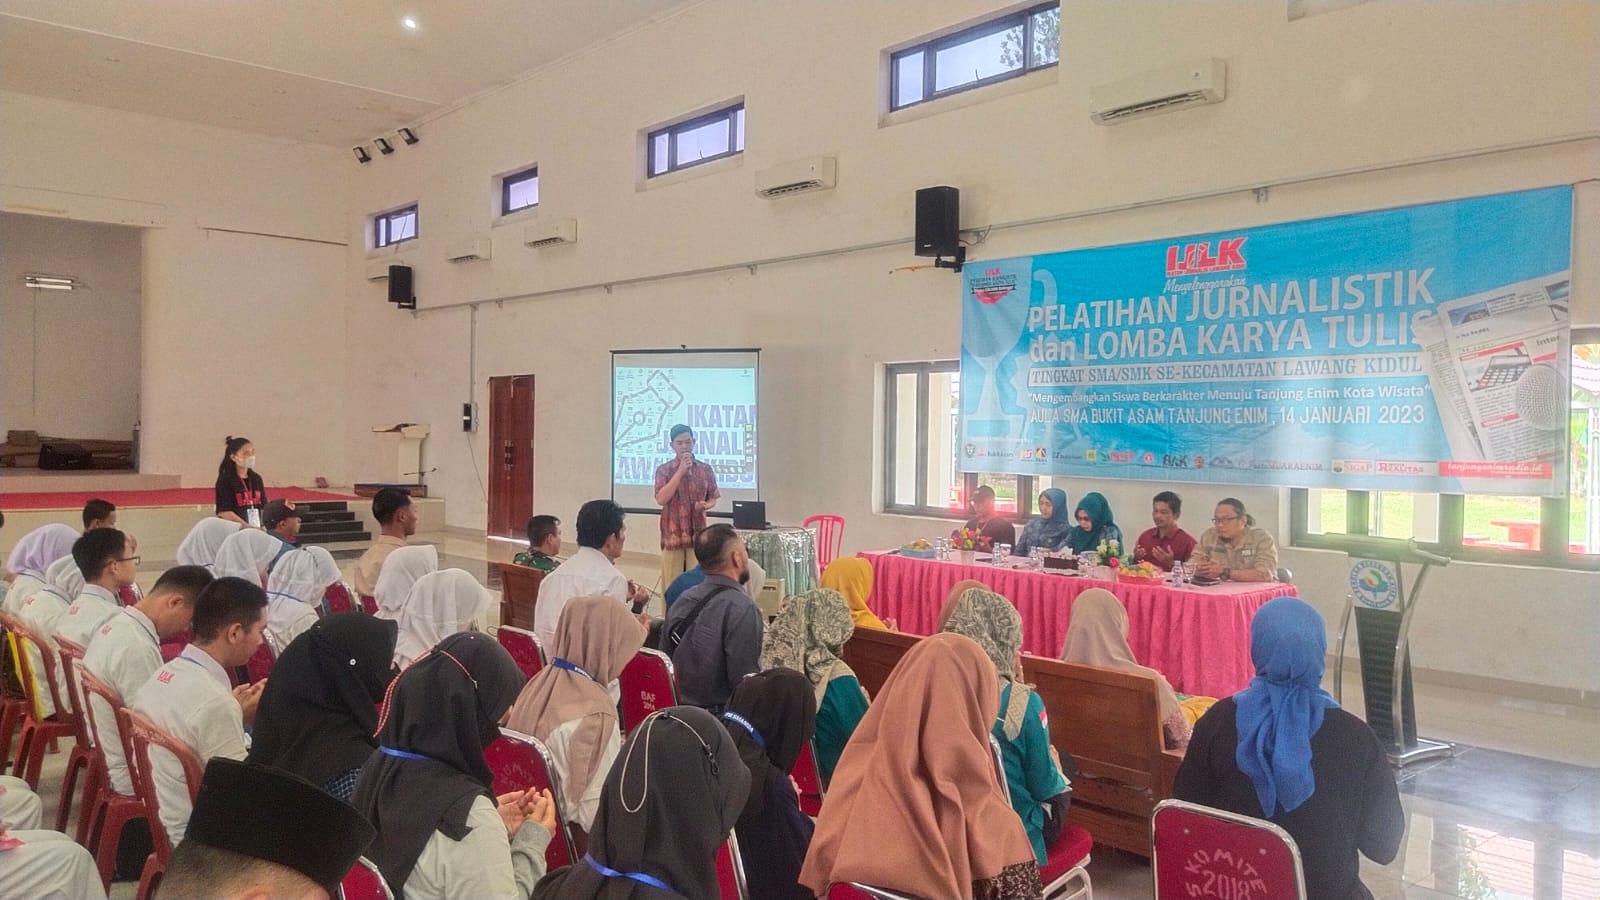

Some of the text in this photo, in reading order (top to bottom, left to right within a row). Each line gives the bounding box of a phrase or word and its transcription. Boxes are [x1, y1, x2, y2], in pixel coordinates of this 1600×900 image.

[1028, 268, 1435, 332] PELATIHAN JURNALISTIK
[1030, 334, 1077, 362] dan
[1083, 327, 1188, 361] LOMBA
[1197, 318, 1312, 355] KARYA
[1032, 355, 1424, 384] TINGKAT SMA/SMK SE-KECAMATAN LAWANG KIDUL
[1112, 391, 1140, 402] Siswa
[1142, 390, 1206, 402] Berkarakter
[1207, 389, 1252, 403] Menuju
[1255, 387, 1303, 401] Tanjung
[1306, 387, 1340, 399] Enim
[1343, 386, 1375, 399] Kota
[1030, 408, 1059, 424] AULA
[1063, 407, 1089, 424] SMA
[1091, 407, 1125, 424] BUKIT
[1127, 407, 1164, 424] ASAM
[1167, 407, 1231, 424] TANJUNG
[1234, 407, 1269, 425] ENIM
[1280, 406, 1296, 424] 14
[1299, 406, 1371, 424] JANUARI
[1377, 404, 1426, 424] 2023
